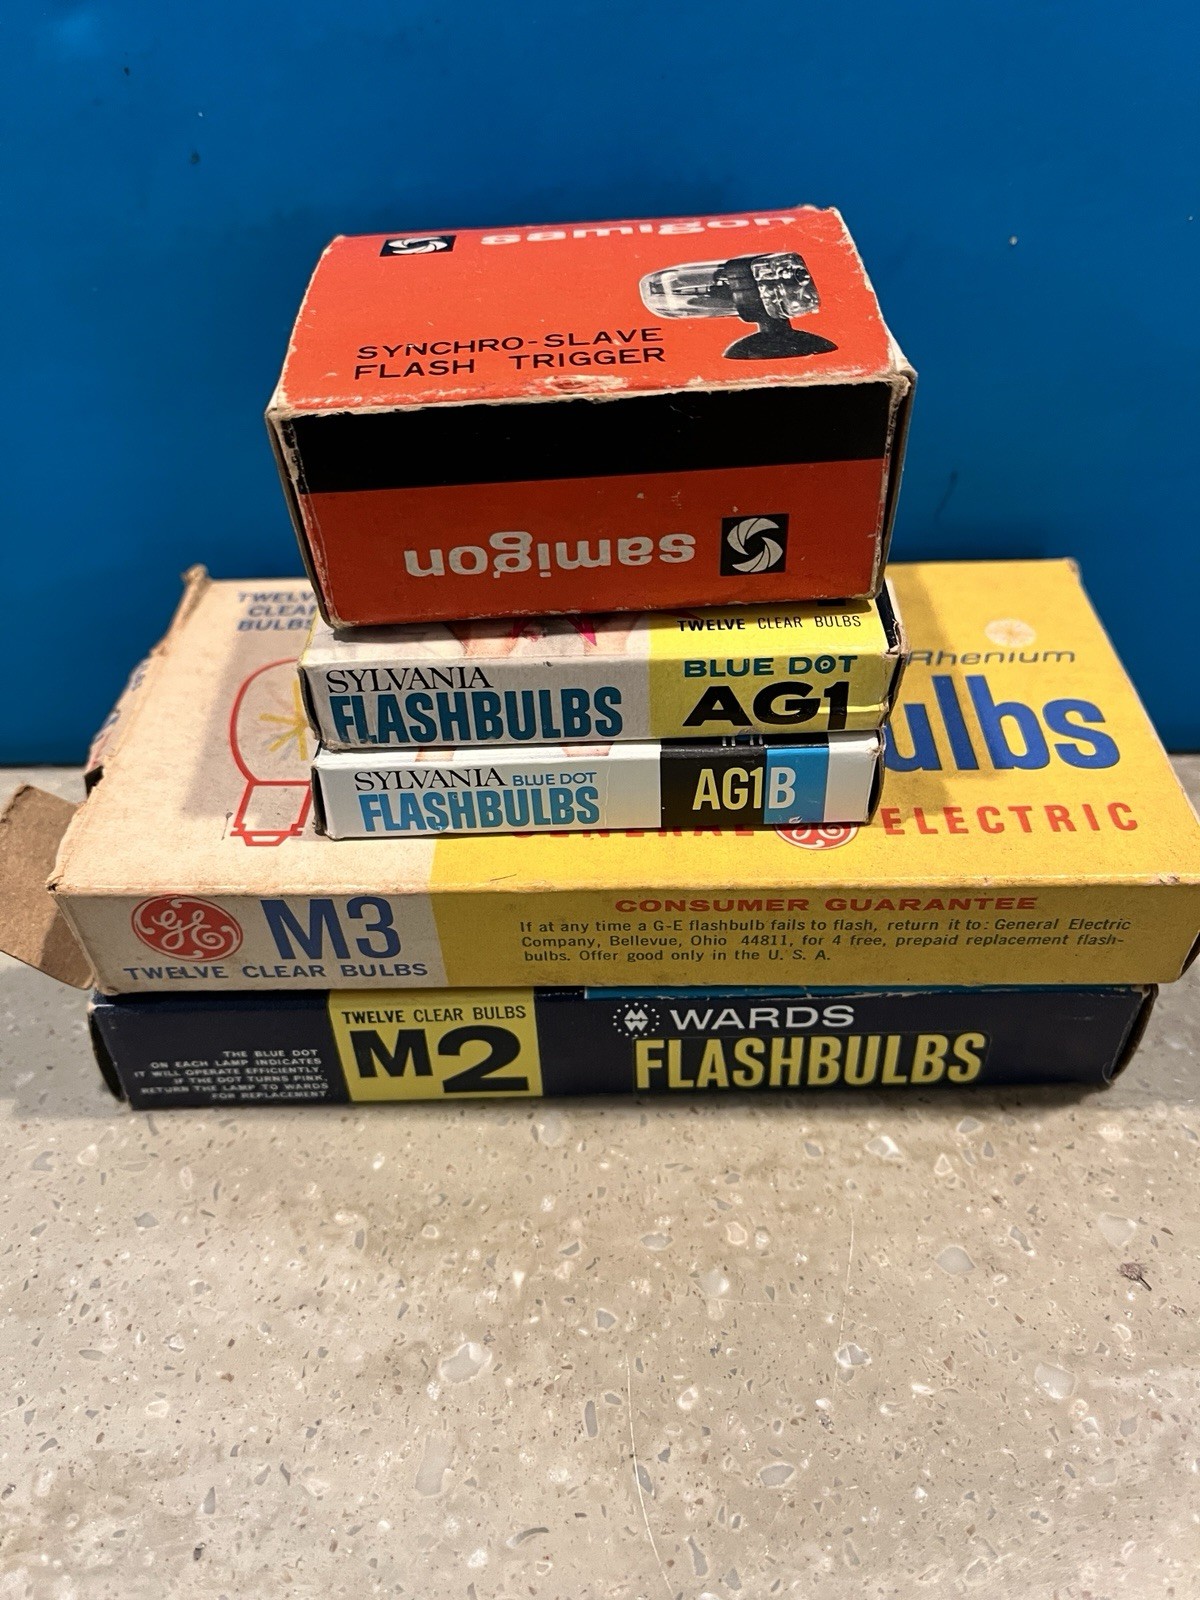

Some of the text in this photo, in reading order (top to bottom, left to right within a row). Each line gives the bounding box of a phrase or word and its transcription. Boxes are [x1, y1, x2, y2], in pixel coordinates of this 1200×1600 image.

[357, 327, 664, 360] SYNCHRO-SLAVE
[354, 347, 666, 380] FLASH TRIGGER
[404, 531, 696, 579] samigon
[238, 591, 315, 602] TWELV
[677, 615, 862, 632] TWELVE CLEAR BULBS
[684, 655, 858, 678] BLUE DOT
[908, 650, 1076, 666] Rhenium
[326, 666, 494, 694] SYLVANIA
[330, 686, 623, 744] FLASHBULBS
[682, 681, 850, 731] AG1
[884, 674, 1121, 772] ulbs
[354, 768, 597, 792] SYLVANIA BLUE DOT
[692, 766, 797, 811] AG1B
[359, 786, 600, 832] FLASHBULBS
[880, 802, 1138, 835] ELECTRIC
[615, 897, 1038, 913] CONSUMER GUARANTEE
[260, 896, 401, 960] M3
[520, 919, 1131, 934] If at any time a G-E flashbulb fails to flash, return it to: General Electric
[522, 933, 1124, 948] Company, Bellevue, Ohio 44811, for 4 free, prepaid replacement flash-
[525, 950, 570, 961] bulbs.
[580, 950, 617, 960] Offer
[627, 950, 663, 962] good
[671, 950, 703, 961] only
[712, 950, 726, 959] in
[735, 949, 759, 959] the
[124, 963, 428, 980] TWELVE CLEAR BULBS
[341, 1005, 527, 1024] TWELVE CLEAR BULBS
[669, 1005, 855, 1031] WARDS
[349, 1025, 529, 1093] M2
[635, 1033, 987, 1088] FLASHBULBS
